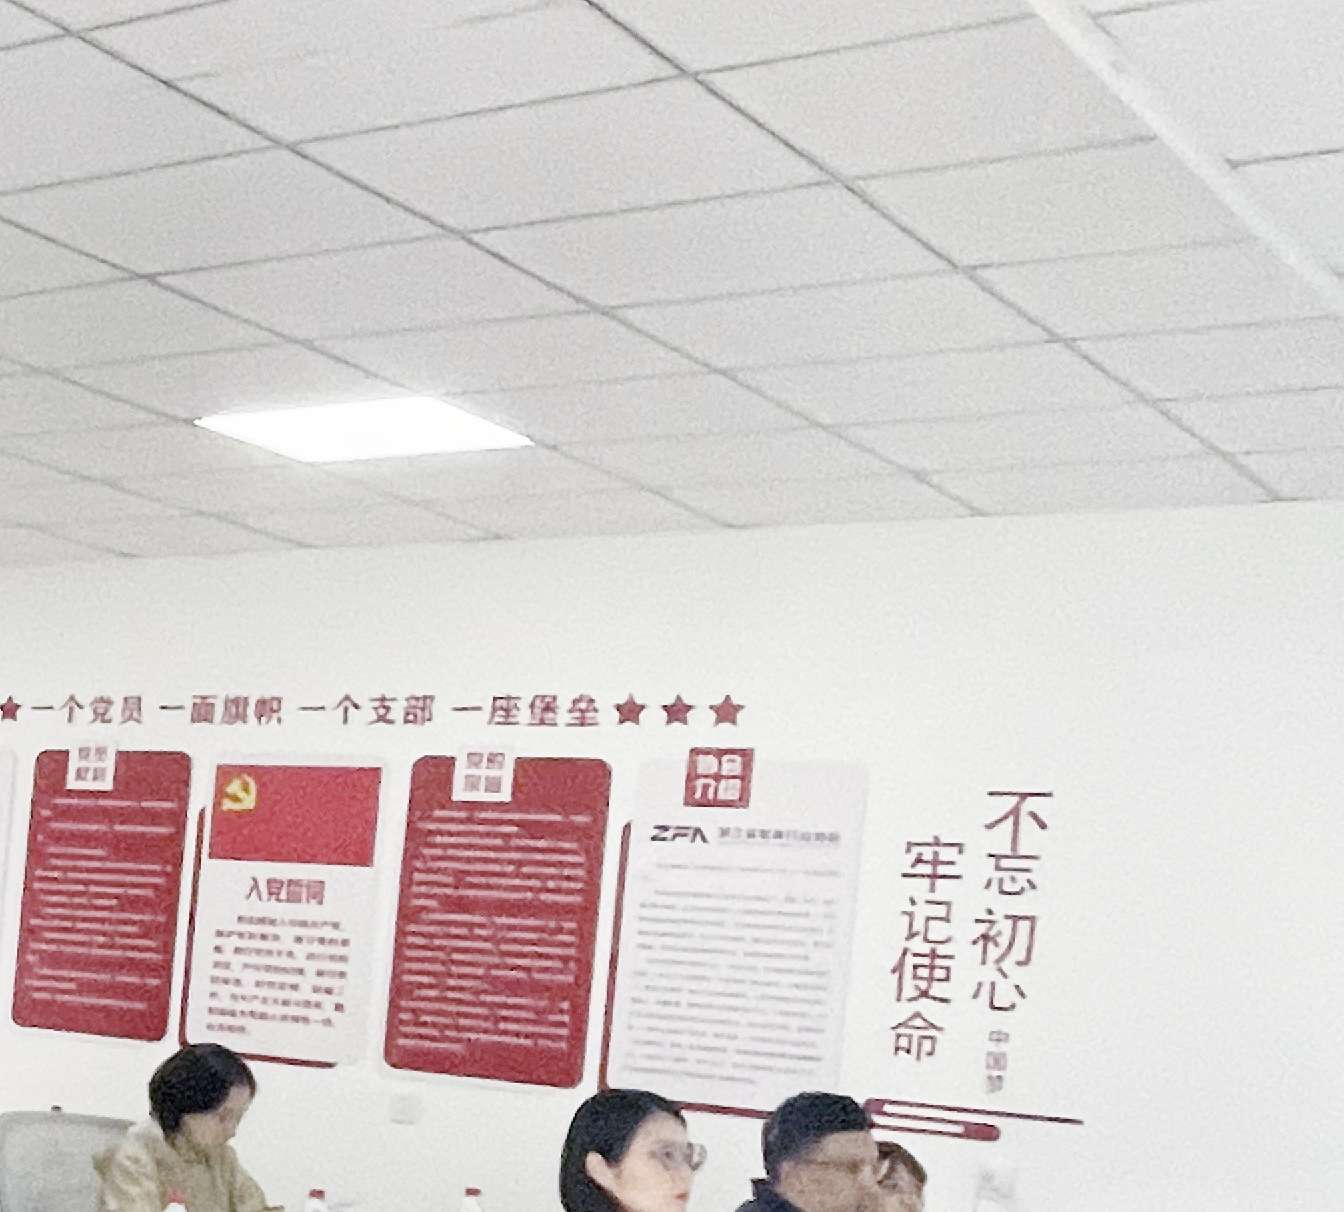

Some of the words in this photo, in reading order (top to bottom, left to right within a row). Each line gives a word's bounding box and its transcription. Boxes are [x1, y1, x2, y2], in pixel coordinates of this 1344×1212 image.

[30, 694, 143, 725] 一个党员
[159, 694, 283, 726] 一面旗帜
[297, 694, 436, 726] 一个支部
[451, 694, 600, 727] 一座堡垒
[890, 835, 965, 1061] 牢记使命
[972, 790, 1054, 1012] 不忘初心
